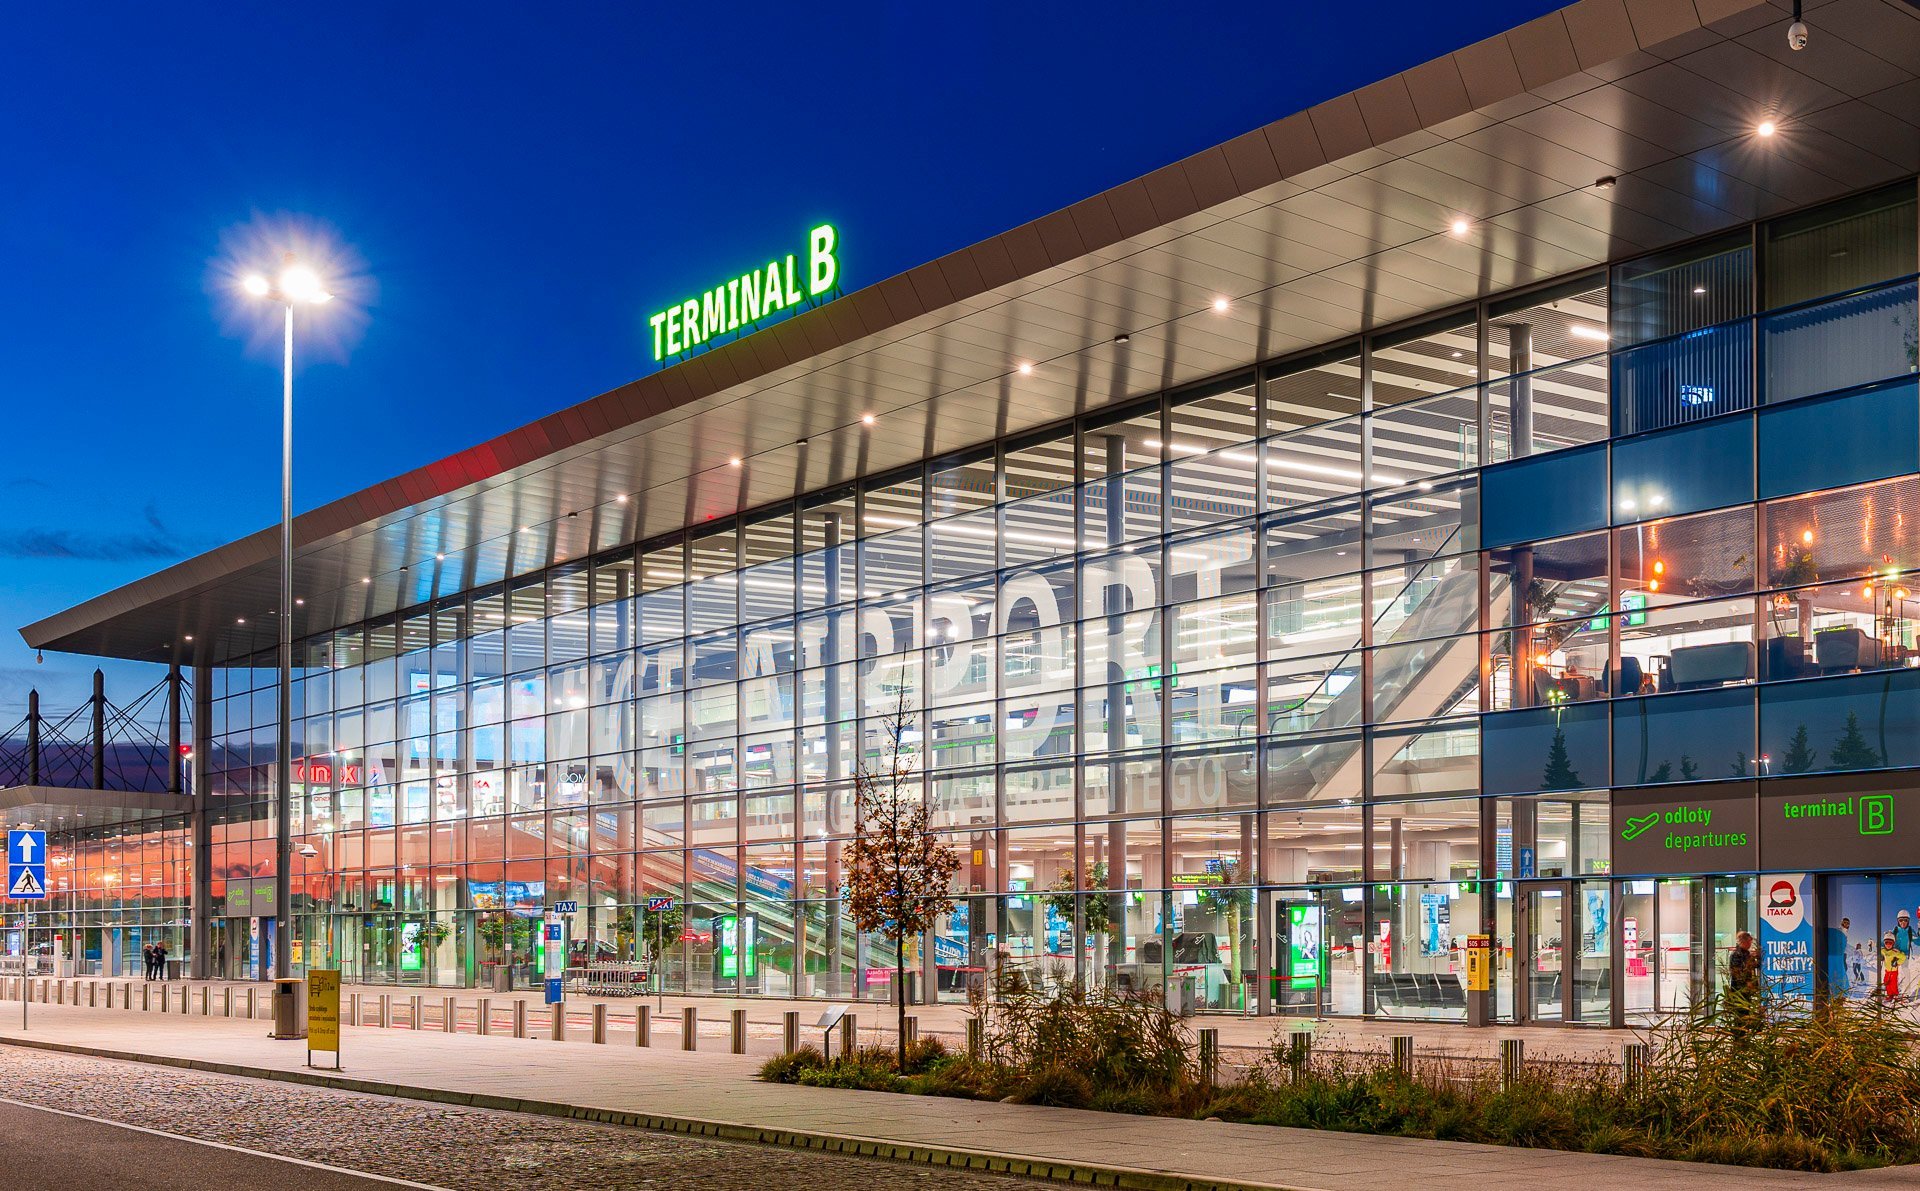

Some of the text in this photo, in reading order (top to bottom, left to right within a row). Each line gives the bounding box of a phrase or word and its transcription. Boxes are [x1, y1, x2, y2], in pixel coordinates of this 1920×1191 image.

[649, 223, 838, 361] TERMINAL B
[735, 527, 1253, 783] AIRPORT
[1664, 806, 1711, 826] odloty
[1783, 797, 1885, 830] terminal B
[1664, 831, 1747, 852] departures
[556, 901, 577, 911] TAXI
[650, 898, 673, 909] TAXI
[1767, 908, 1793, 916] ITAKA
[1766, 940, 1808, 955] TURCJA
[1773, 956, 1814, 971] NARTY?
